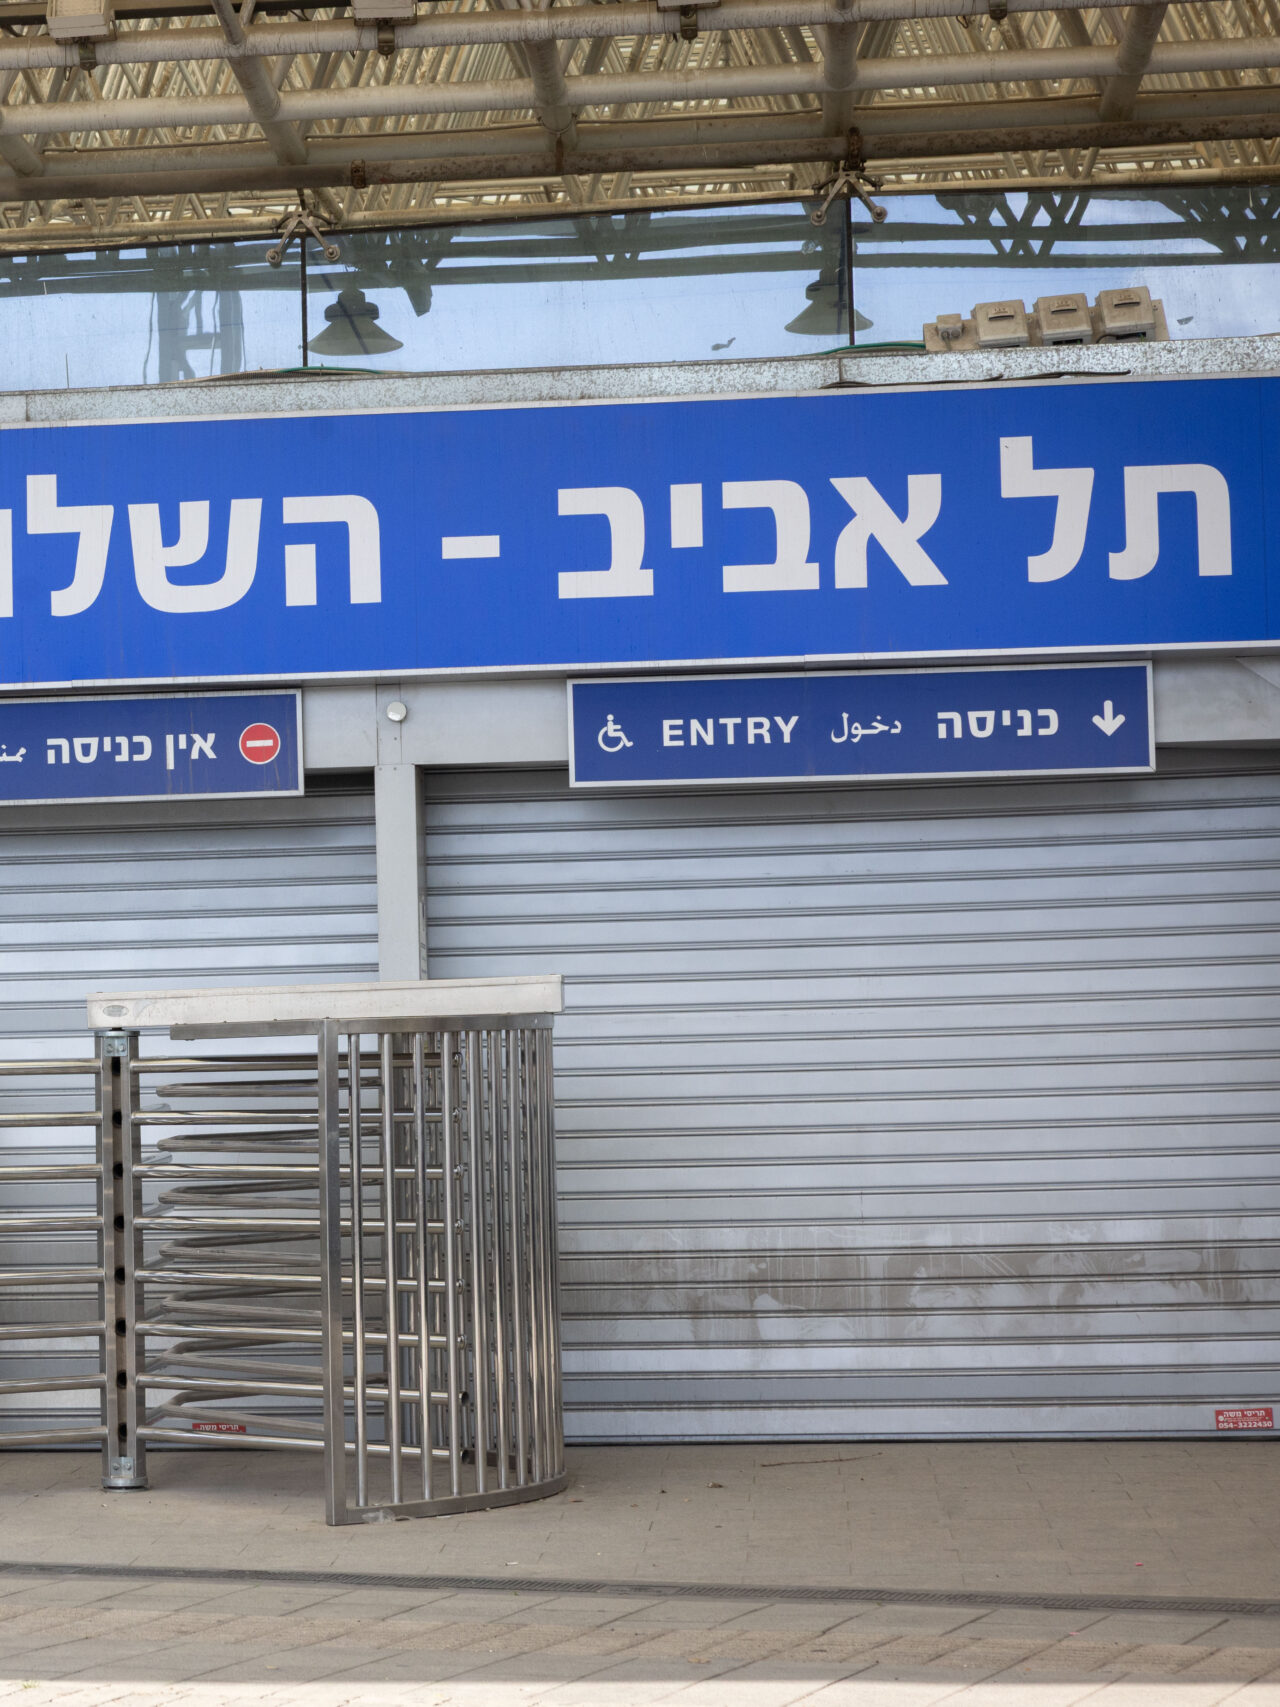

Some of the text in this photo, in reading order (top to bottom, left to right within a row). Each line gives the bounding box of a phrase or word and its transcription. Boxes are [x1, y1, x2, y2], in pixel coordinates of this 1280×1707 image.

[1000, 436, 1232, 582] תל
[442, 535, 500, 559] -
[558, 474, 948, 599] אביב
[663, 716, 798, 746] ENTRY
[831, 713, 901, 743] دخول
[938, 709, 1058, 738] כניסה
[47, 733, 216, 770] אין כניסה
[219, 1423, 239, 1431] תריסי
